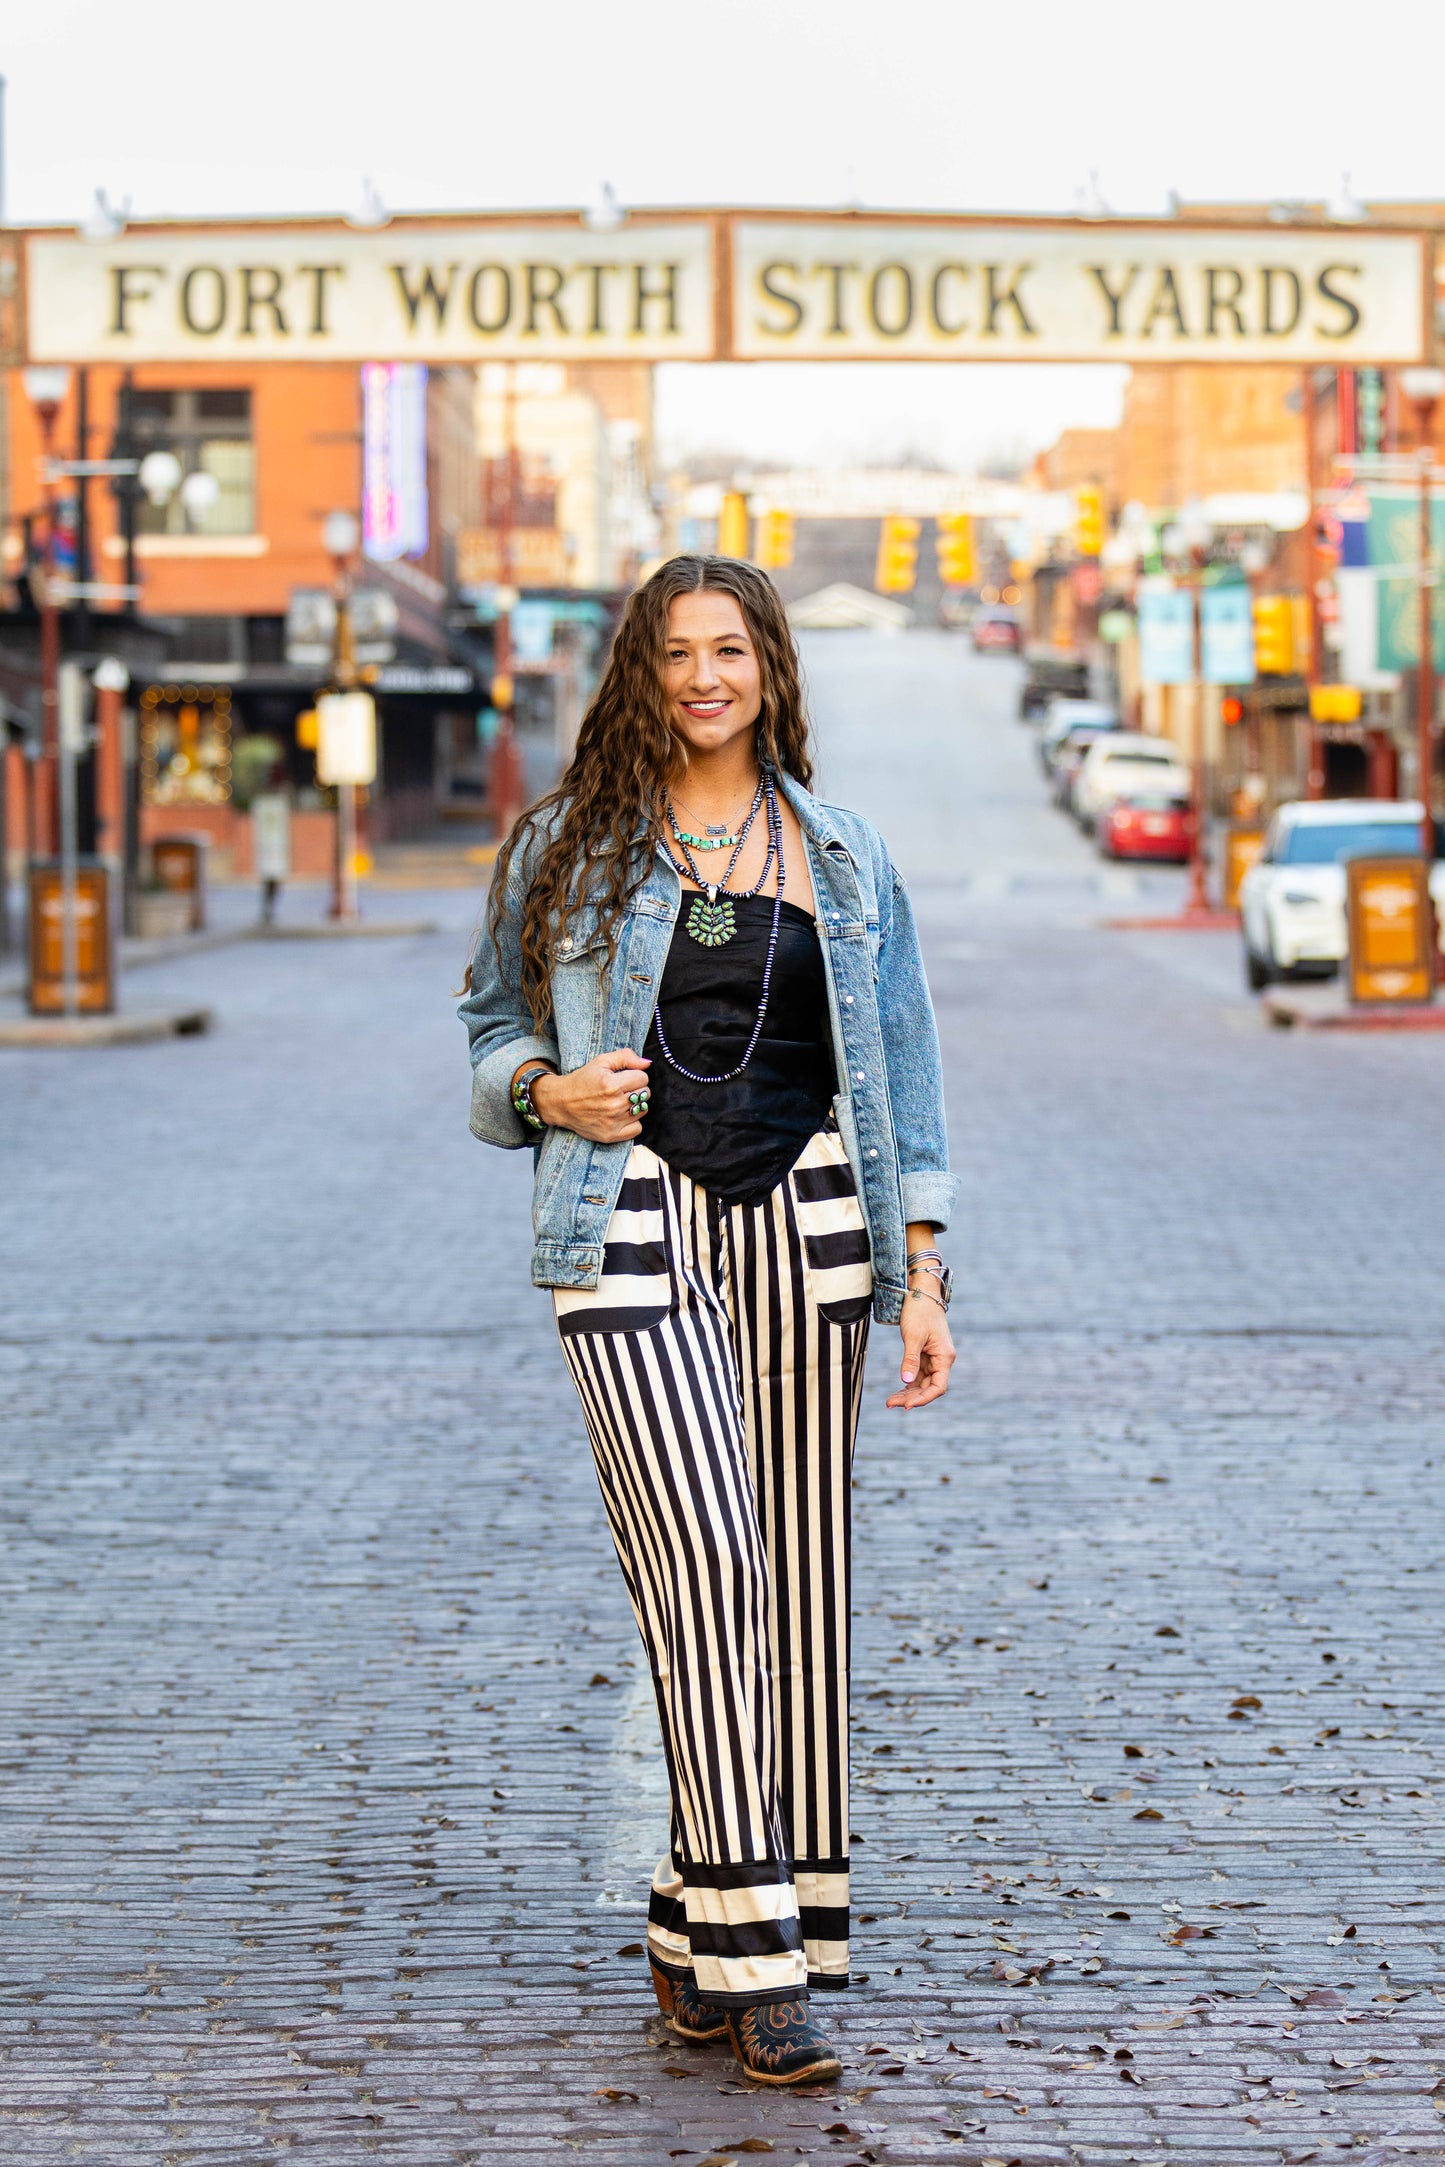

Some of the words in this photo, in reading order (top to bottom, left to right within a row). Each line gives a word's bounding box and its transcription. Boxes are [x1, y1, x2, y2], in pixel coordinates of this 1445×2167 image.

[109, 265, 342, 336] FORT
[388, 262, 684, 336] WORTH
[759, 262, 1036, 337] STOCK
[1087, 264, 1363, 338] YARDS
